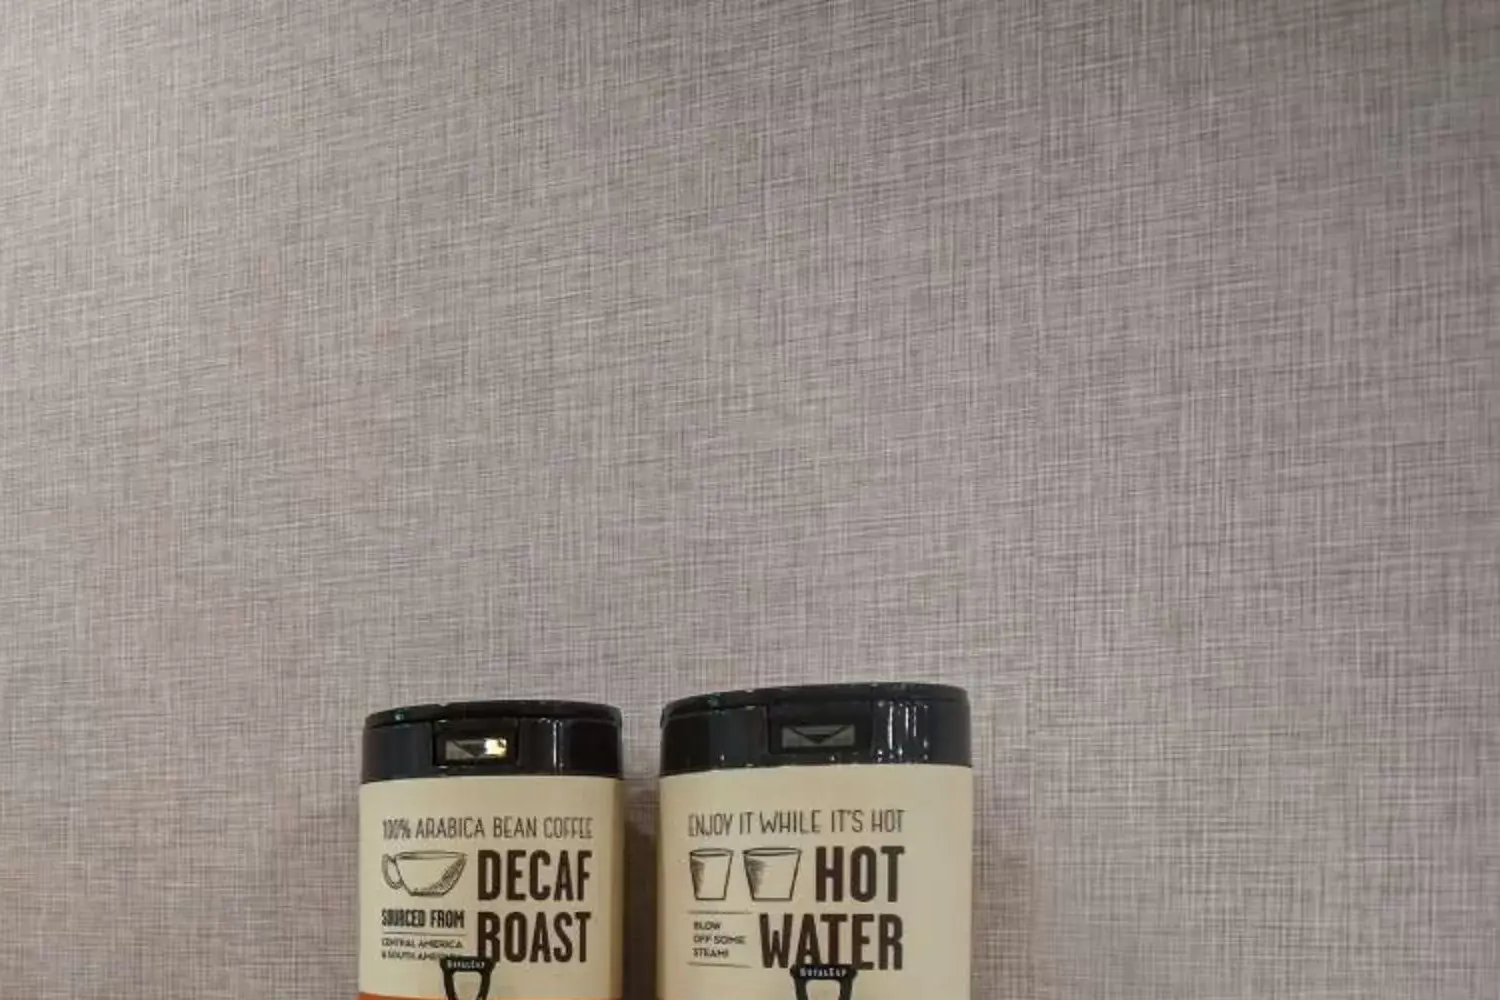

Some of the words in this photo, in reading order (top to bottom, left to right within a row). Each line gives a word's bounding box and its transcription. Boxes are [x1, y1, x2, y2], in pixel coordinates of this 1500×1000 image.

[382, 819, 411, 840] 100%
[415, 817, 485, 840] ARABICA
[493, 816, 537, 838] BEAN
[544, 817, 593, 839] COFFEE
[688, 812, 733, 837] ENJOY
[739, 811, 754, 834] IT
[759, 810, 822, 834] WHILE
[831, 809, 864, 833] IT'S
[871, 809, 905, 833] HOT
[477, 849, 593, 901] DECAF
[815, 846, 905, 903] HOT
[381, 909, 426, 928] SOURCED
[430, 909, 465, 929] FROM
[693, 921, 721, 931] BLOW
[418, 939, 464, 949] AMERICA
[477, 910, 592, 963] ROAST
[713, 935, 746, 945] SOME
[759, 912, 905, 971] WATER
